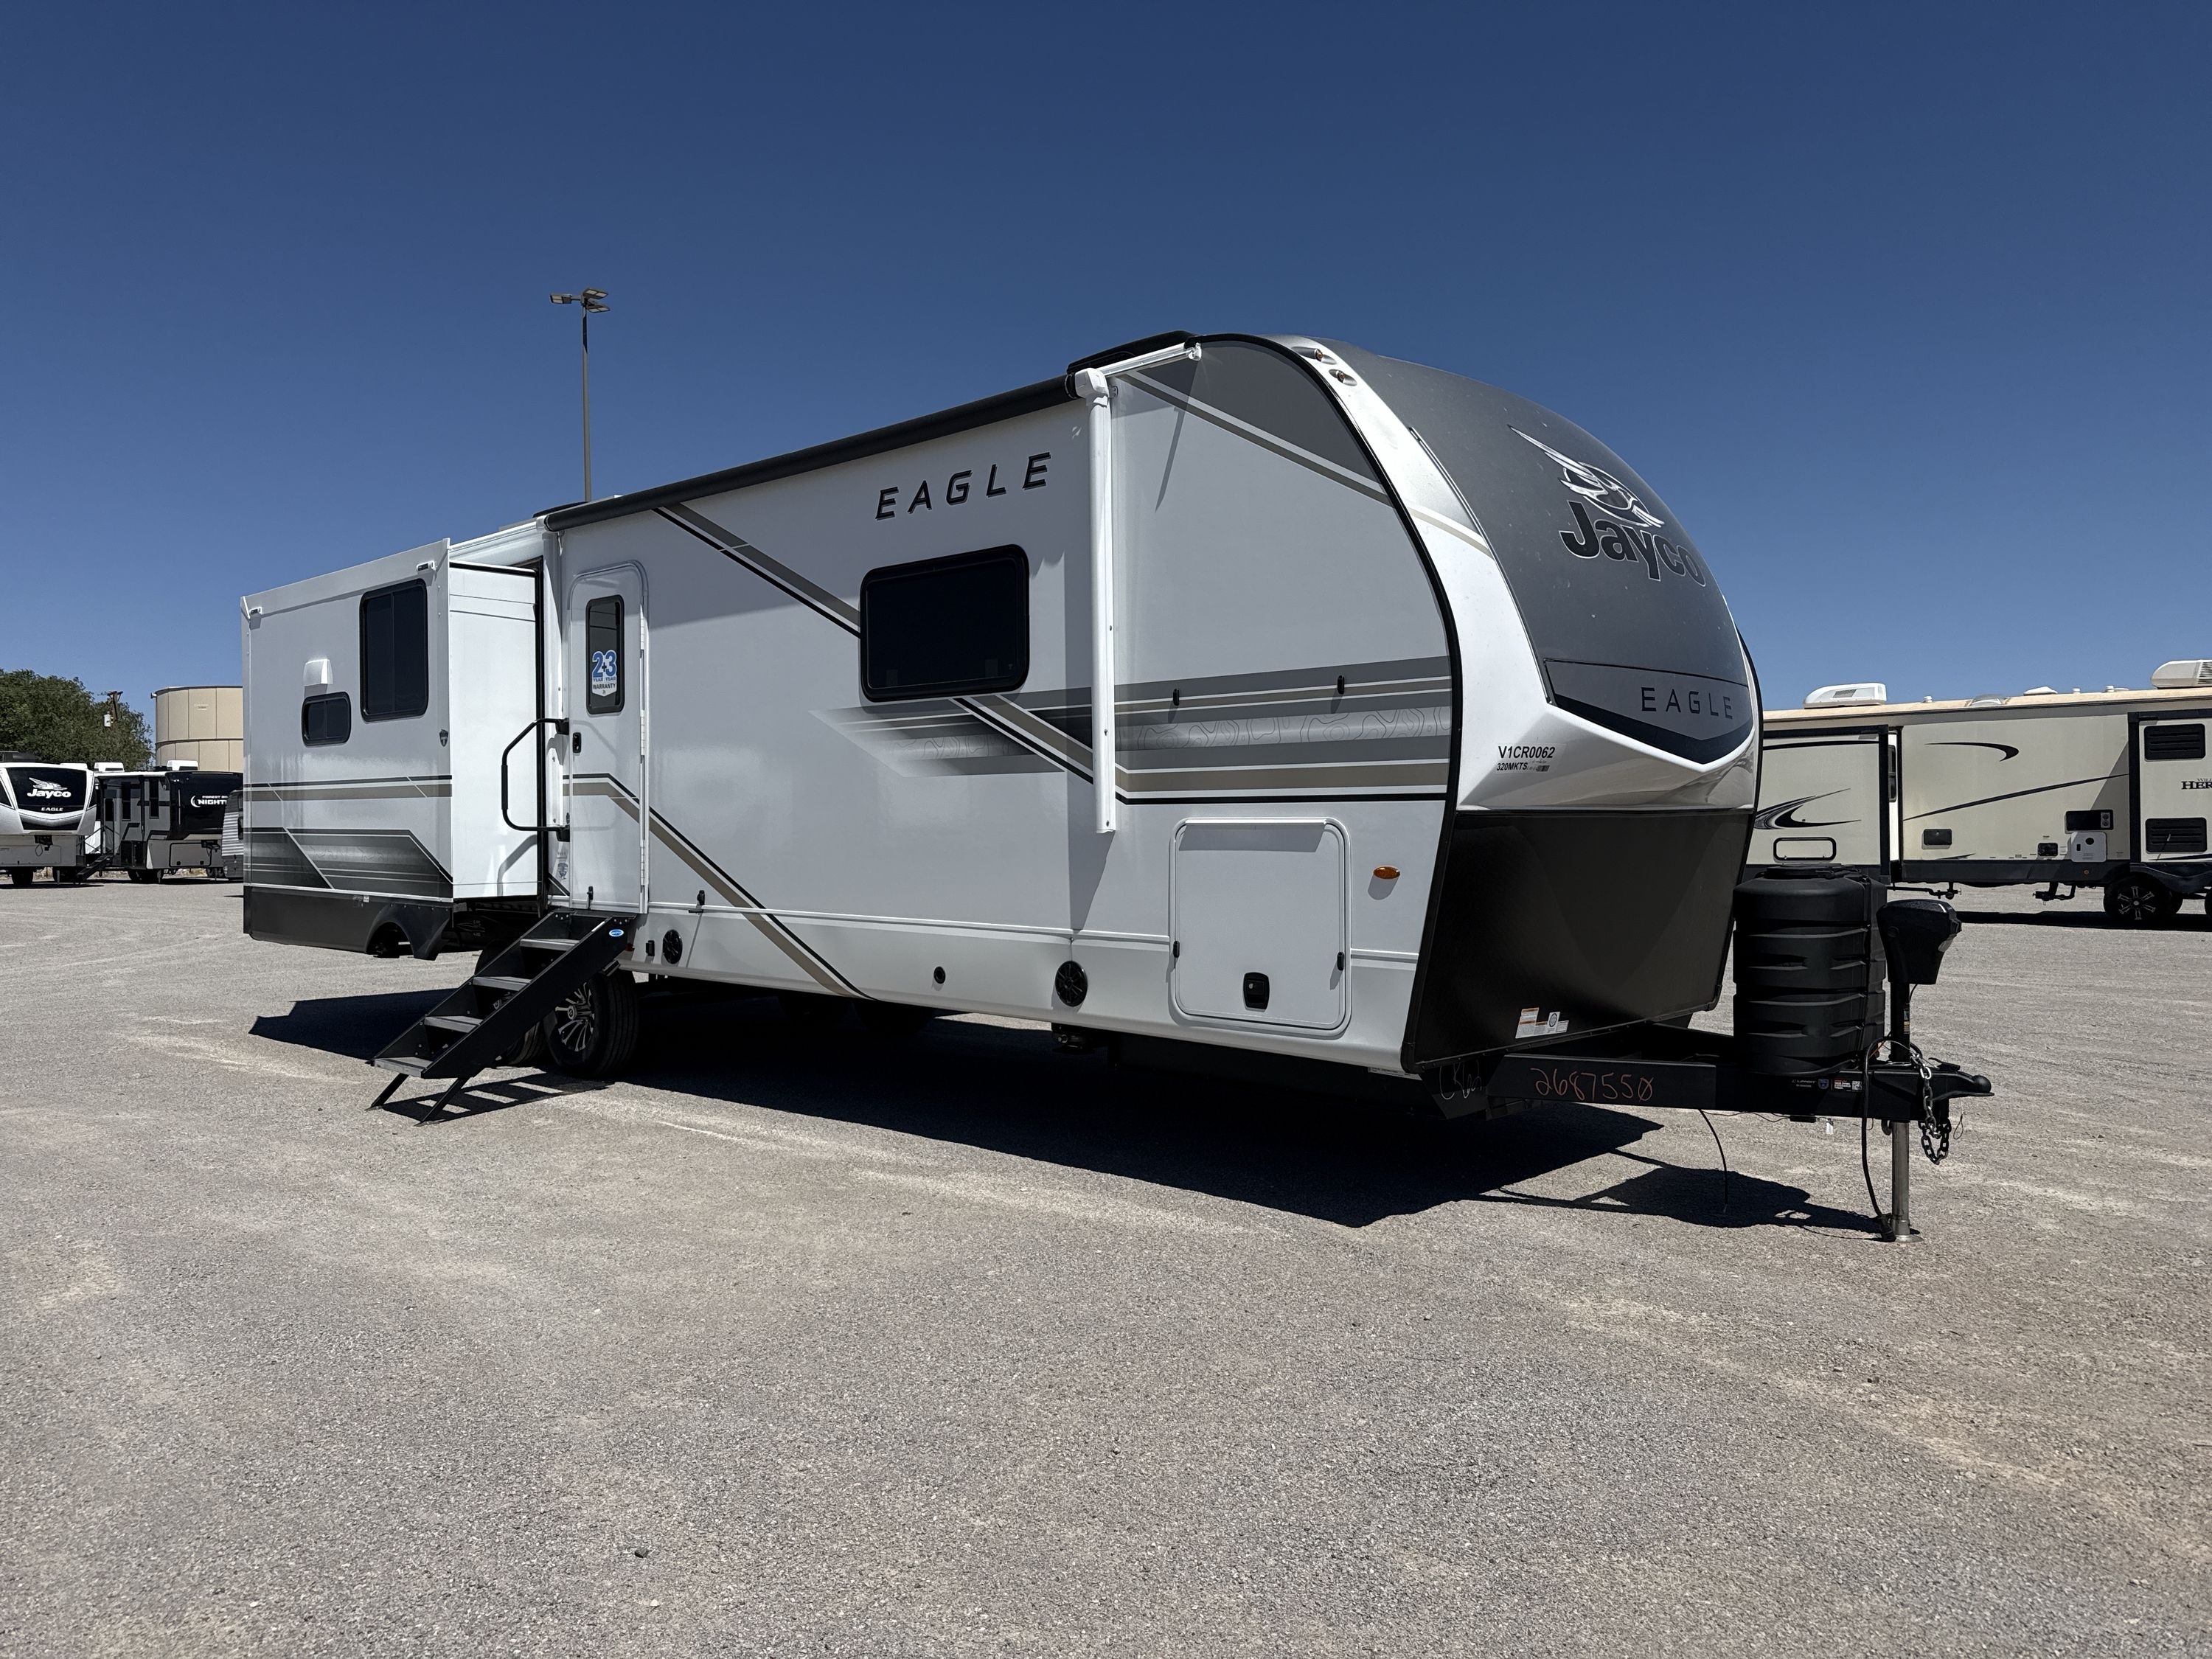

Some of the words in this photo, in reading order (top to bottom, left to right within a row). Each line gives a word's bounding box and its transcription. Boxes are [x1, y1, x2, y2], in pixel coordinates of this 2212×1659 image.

[875, 451, 1051, 521] EAGLE
[1558, 499, 1706, 587] Jayco
[1641, 686, 1733, 720] EAGLE
[1498, 745, 1556, 759] V1CR0062
[1496, 762, 1528, 771] 320MKTS
[27, 788, 72, 799] Jayco
